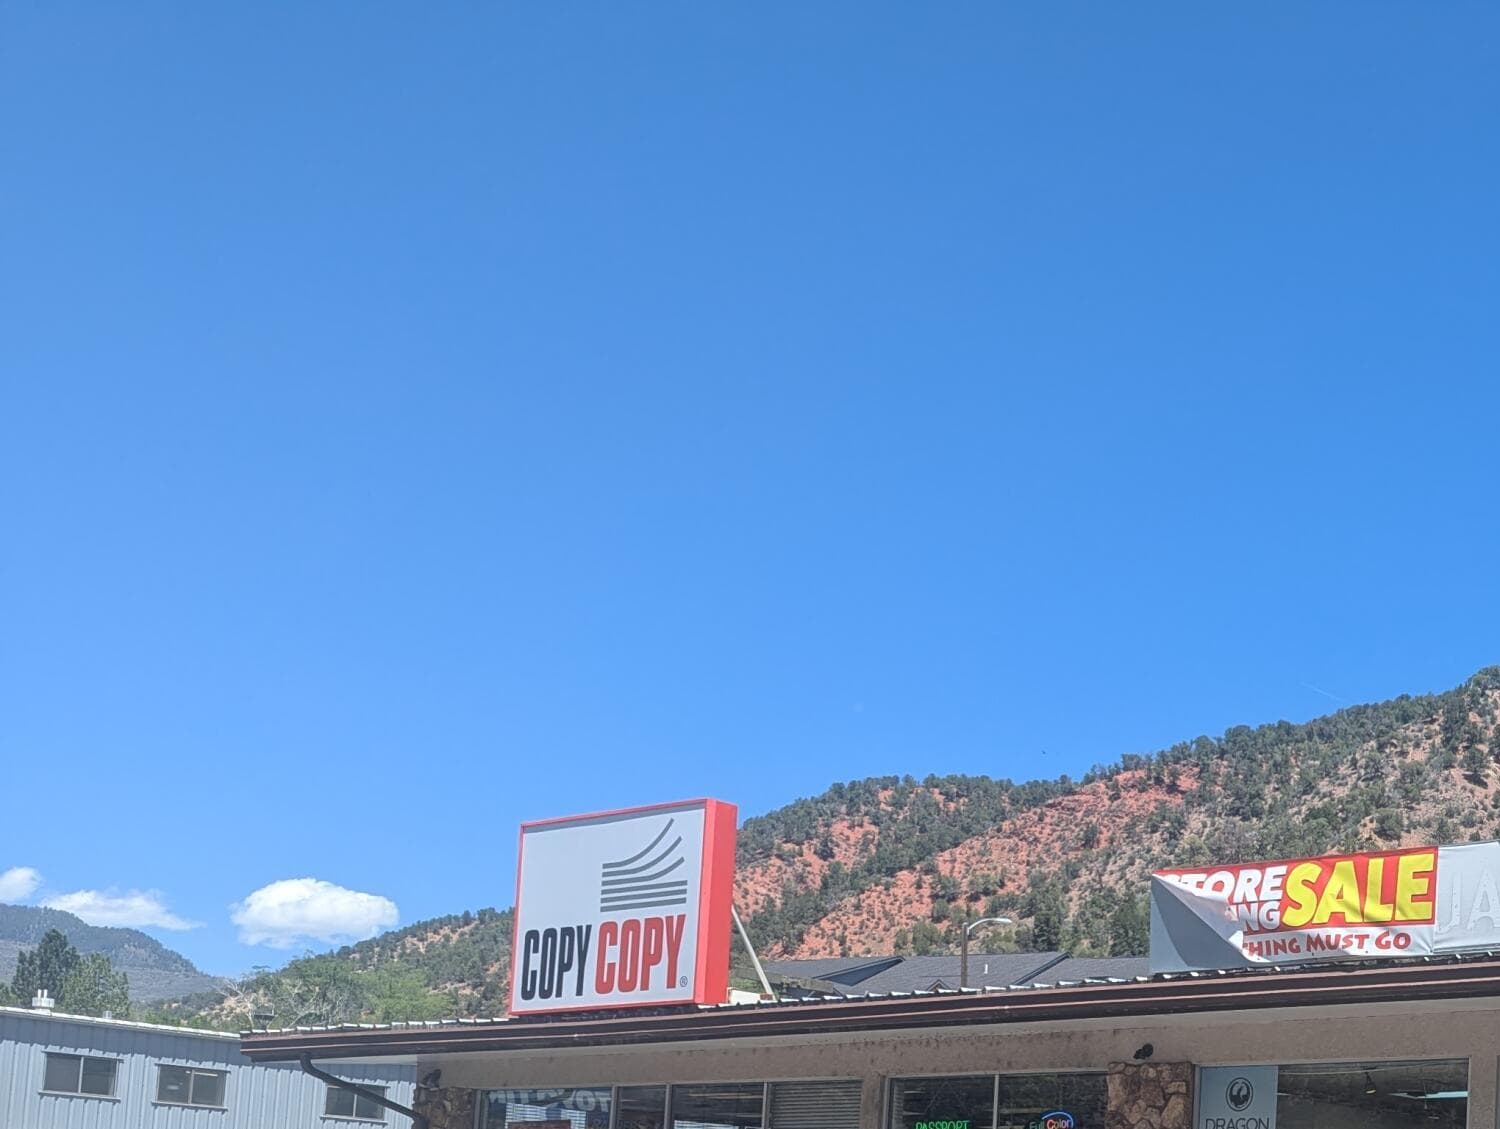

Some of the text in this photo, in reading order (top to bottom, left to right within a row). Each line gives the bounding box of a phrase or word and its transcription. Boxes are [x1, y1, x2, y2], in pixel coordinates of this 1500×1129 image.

[1282, 853, 1434, 927] SALE
[521, 924, 592, 1000] COPY
[1306, 932, 1370, 952] MUST
[1375, 931, 1411, 950] GO
[1046, 1119, 1073, 1129] Color
